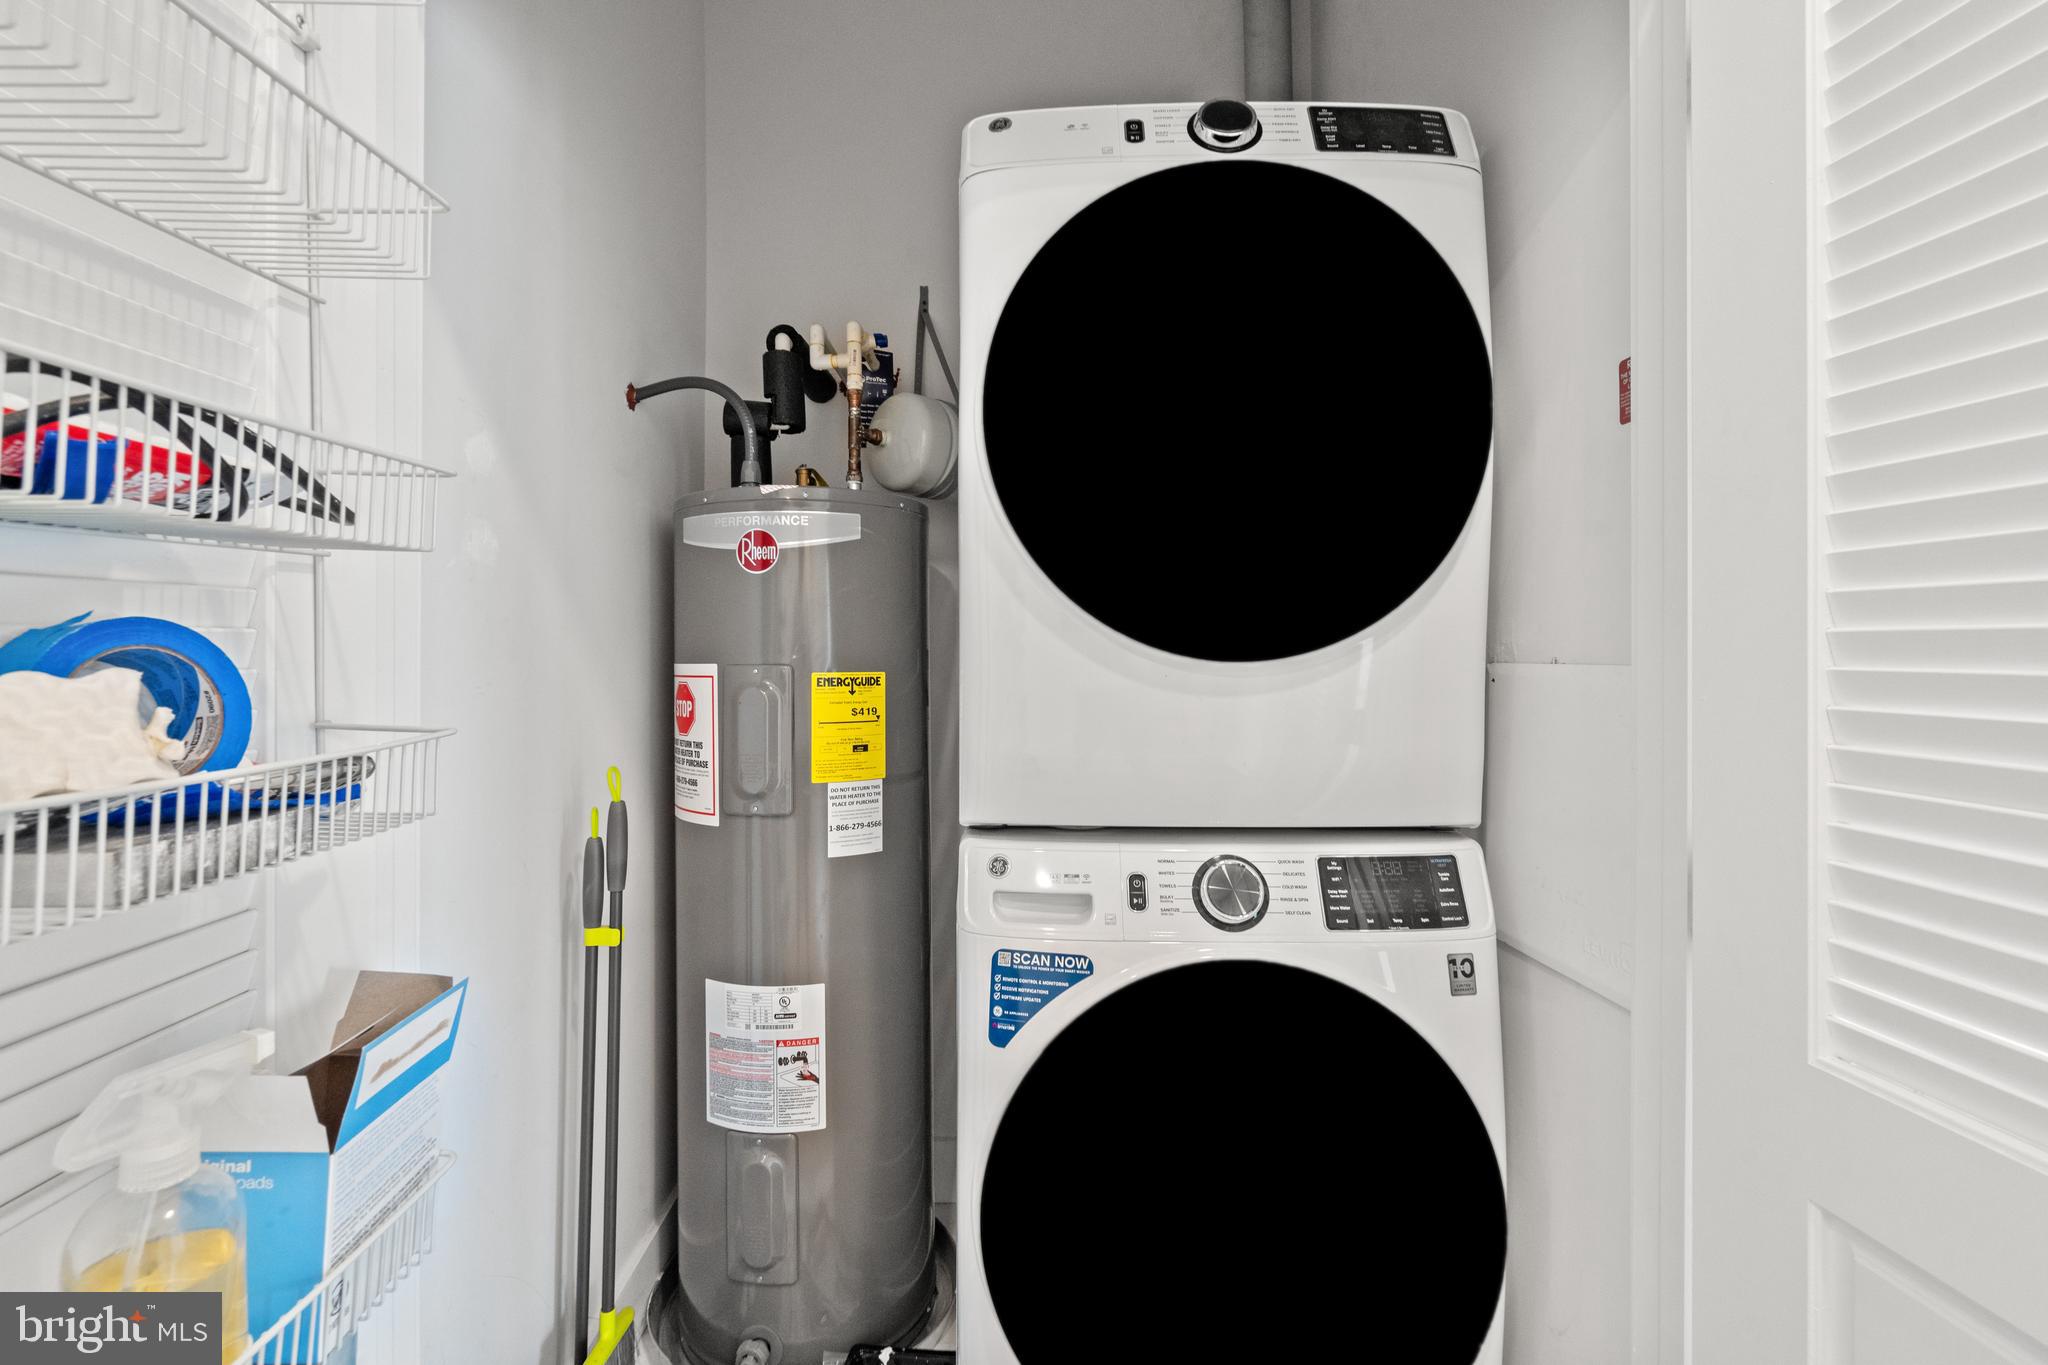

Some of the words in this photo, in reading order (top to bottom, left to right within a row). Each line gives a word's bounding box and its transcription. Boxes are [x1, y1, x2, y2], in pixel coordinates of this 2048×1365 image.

[714, 515, 809, 527] PERFORMANCE
[741, 531, 776, 566] Rheem
[676, 700, 692, 718] STOP
[693, 741, 703, 750] THIS
[680, 748, 693, 757] HEATER
[694, 750, 700, 759] TO
[686, 758, 709, 768] PURCHASE
[829, 820, 881, 832] 1-866-279-4566
[1013, 952, 1050, 967] SCAN
[1055, 956, 1089, 969] NOW
[1018, 987, 1049, 995] NOTIFICATIONS
